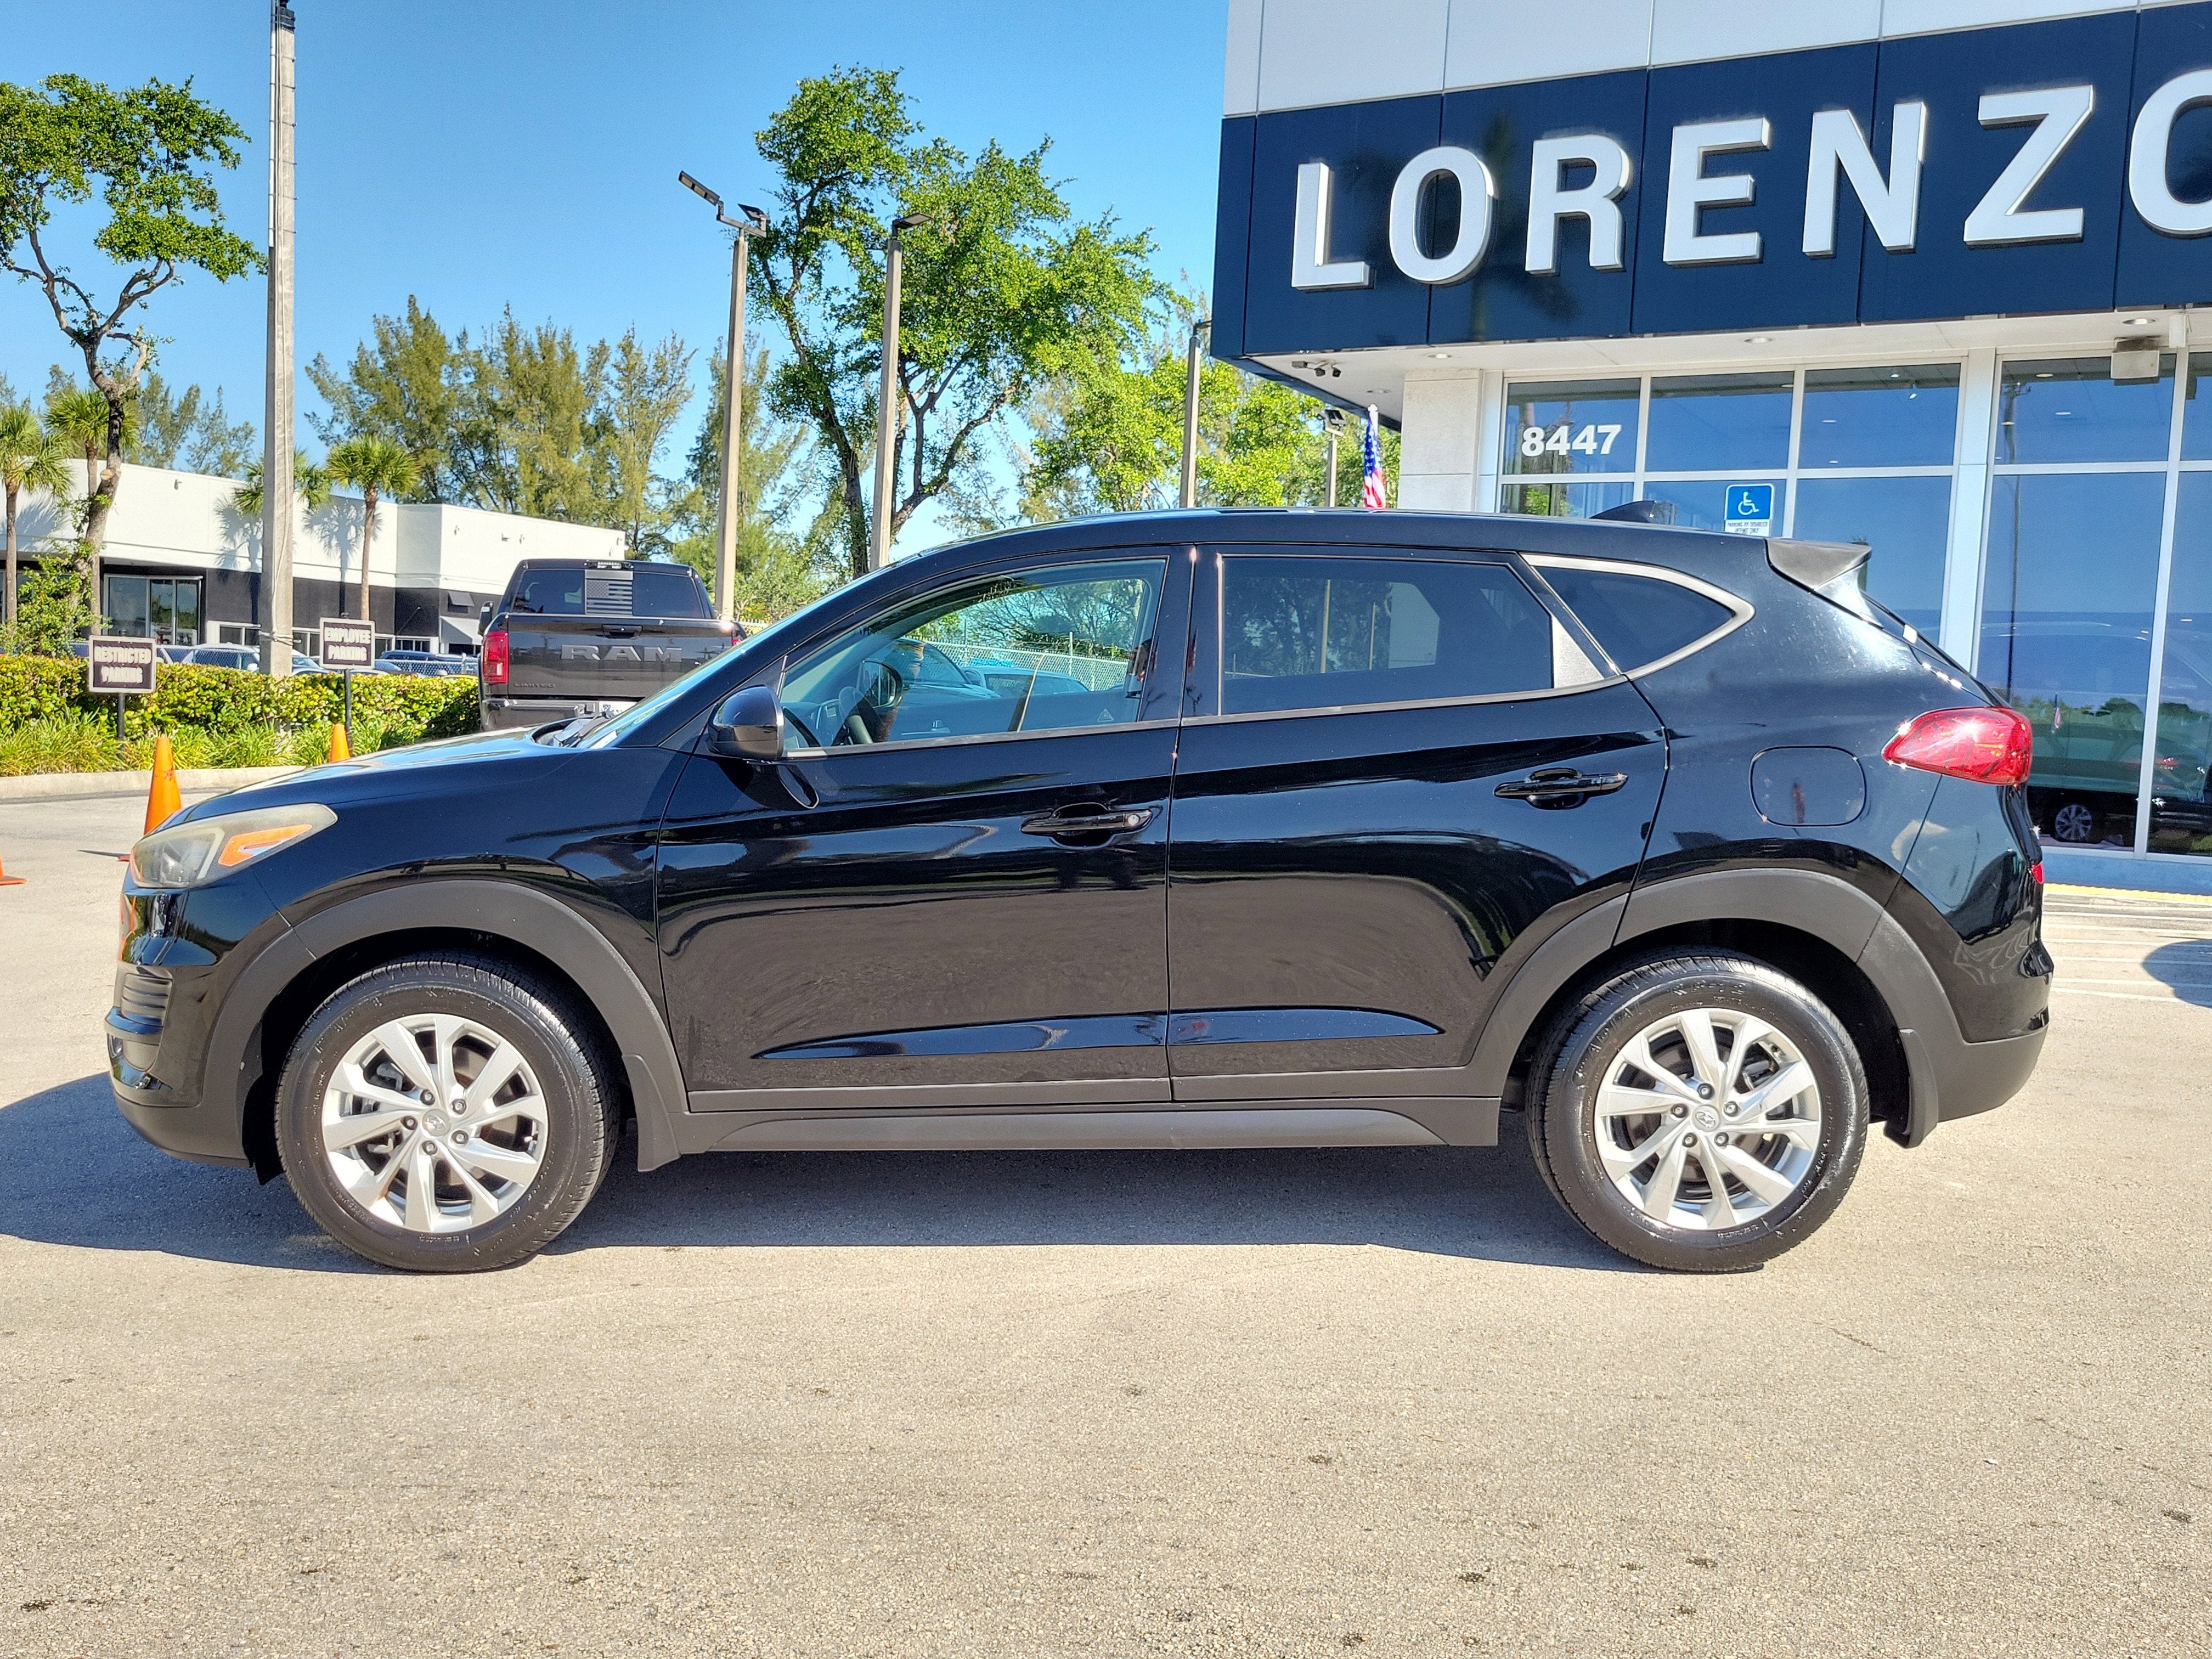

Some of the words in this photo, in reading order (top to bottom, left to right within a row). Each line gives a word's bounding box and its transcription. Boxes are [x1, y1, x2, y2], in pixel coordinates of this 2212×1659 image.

[1291, 69, 2212, 289] LORENZO
[1521, 424, 1622, 456] 8447
[324, 627, 371, 644] EMPLOYEE
[94, 646, 151, 664] RESTRICTED
[328, 645, 367, 661] PARKING
[561, 645, 682, 662] RAM
[101, 666, 143, 683] PARKING
